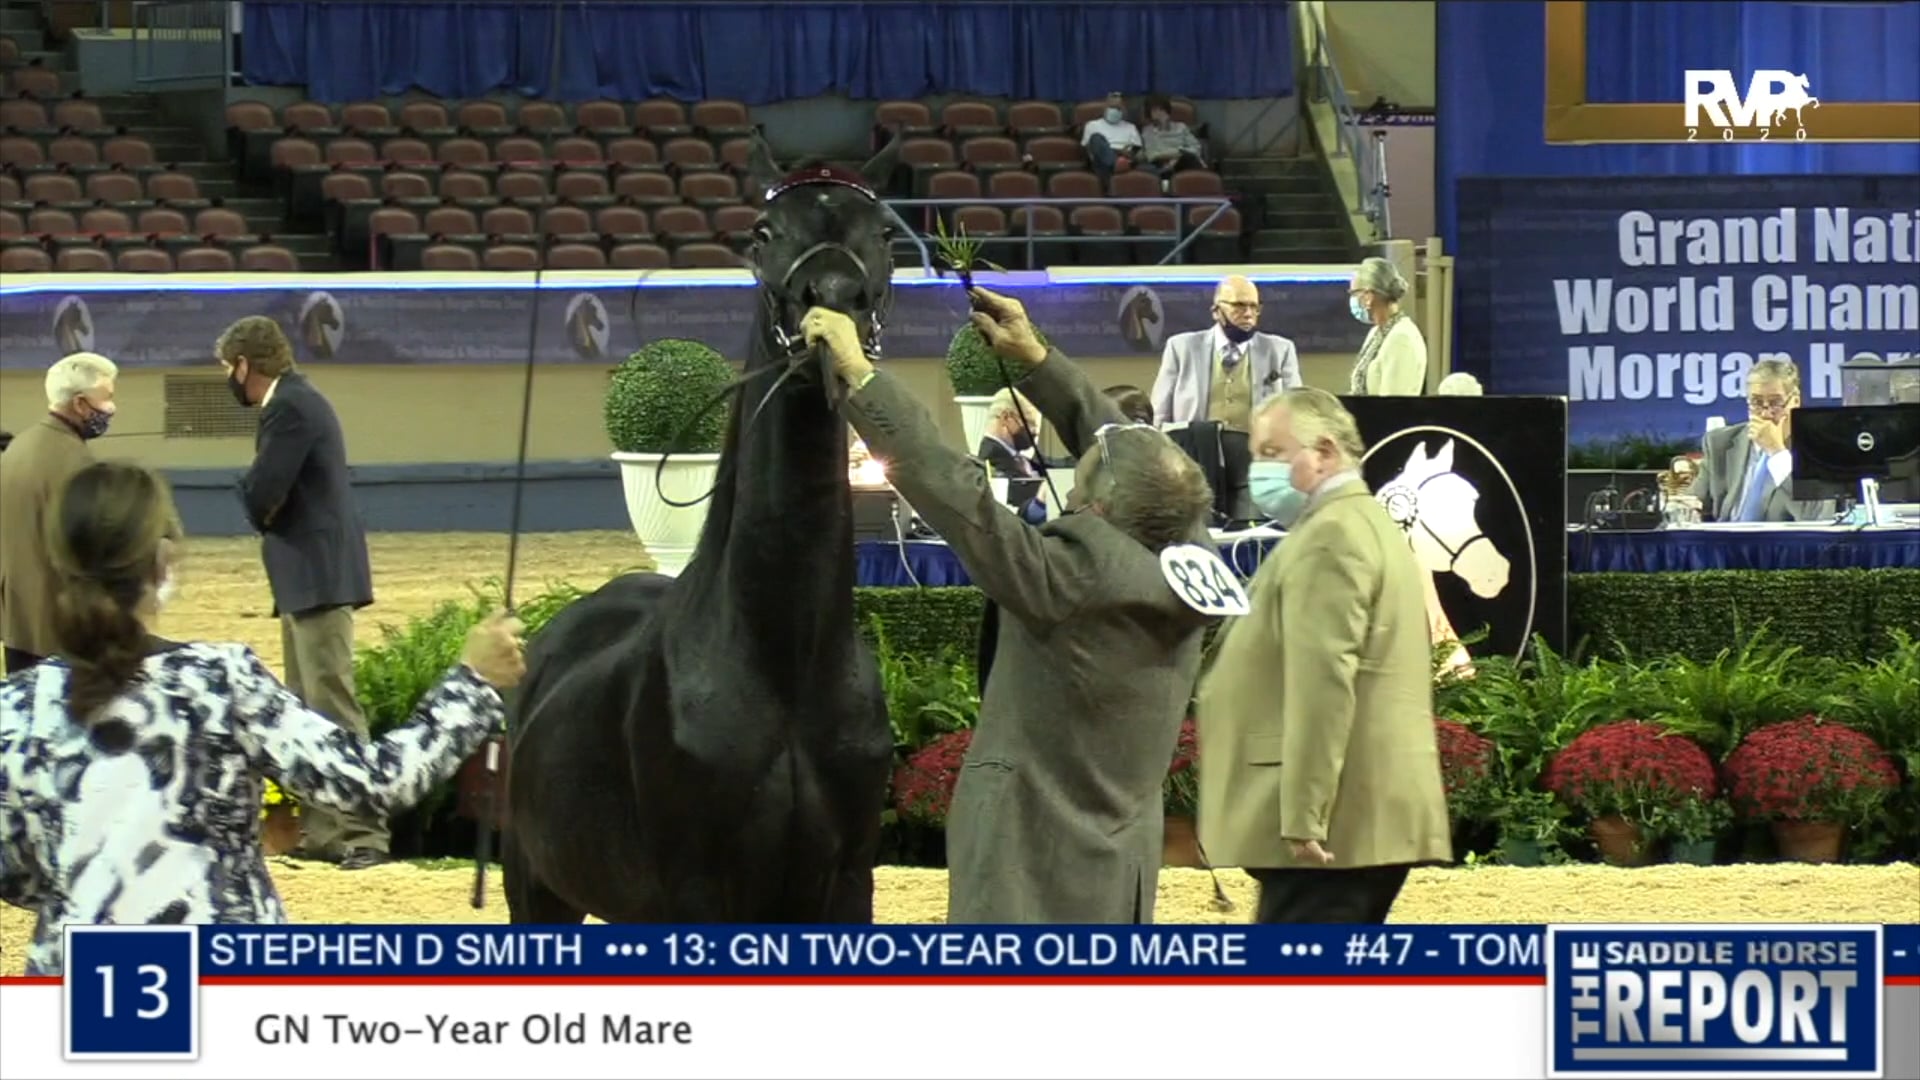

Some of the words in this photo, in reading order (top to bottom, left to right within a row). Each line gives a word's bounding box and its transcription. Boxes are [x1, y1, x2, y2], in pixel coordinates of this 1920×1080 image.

[1618, 207, 1797, 267] Grand
[1553, 276, 1735, 335] World
[1751, 274, 1919, 332] Cham
[1568, 346, 1792, 405] Morga
[1168, 559, 1244, 608] 834
